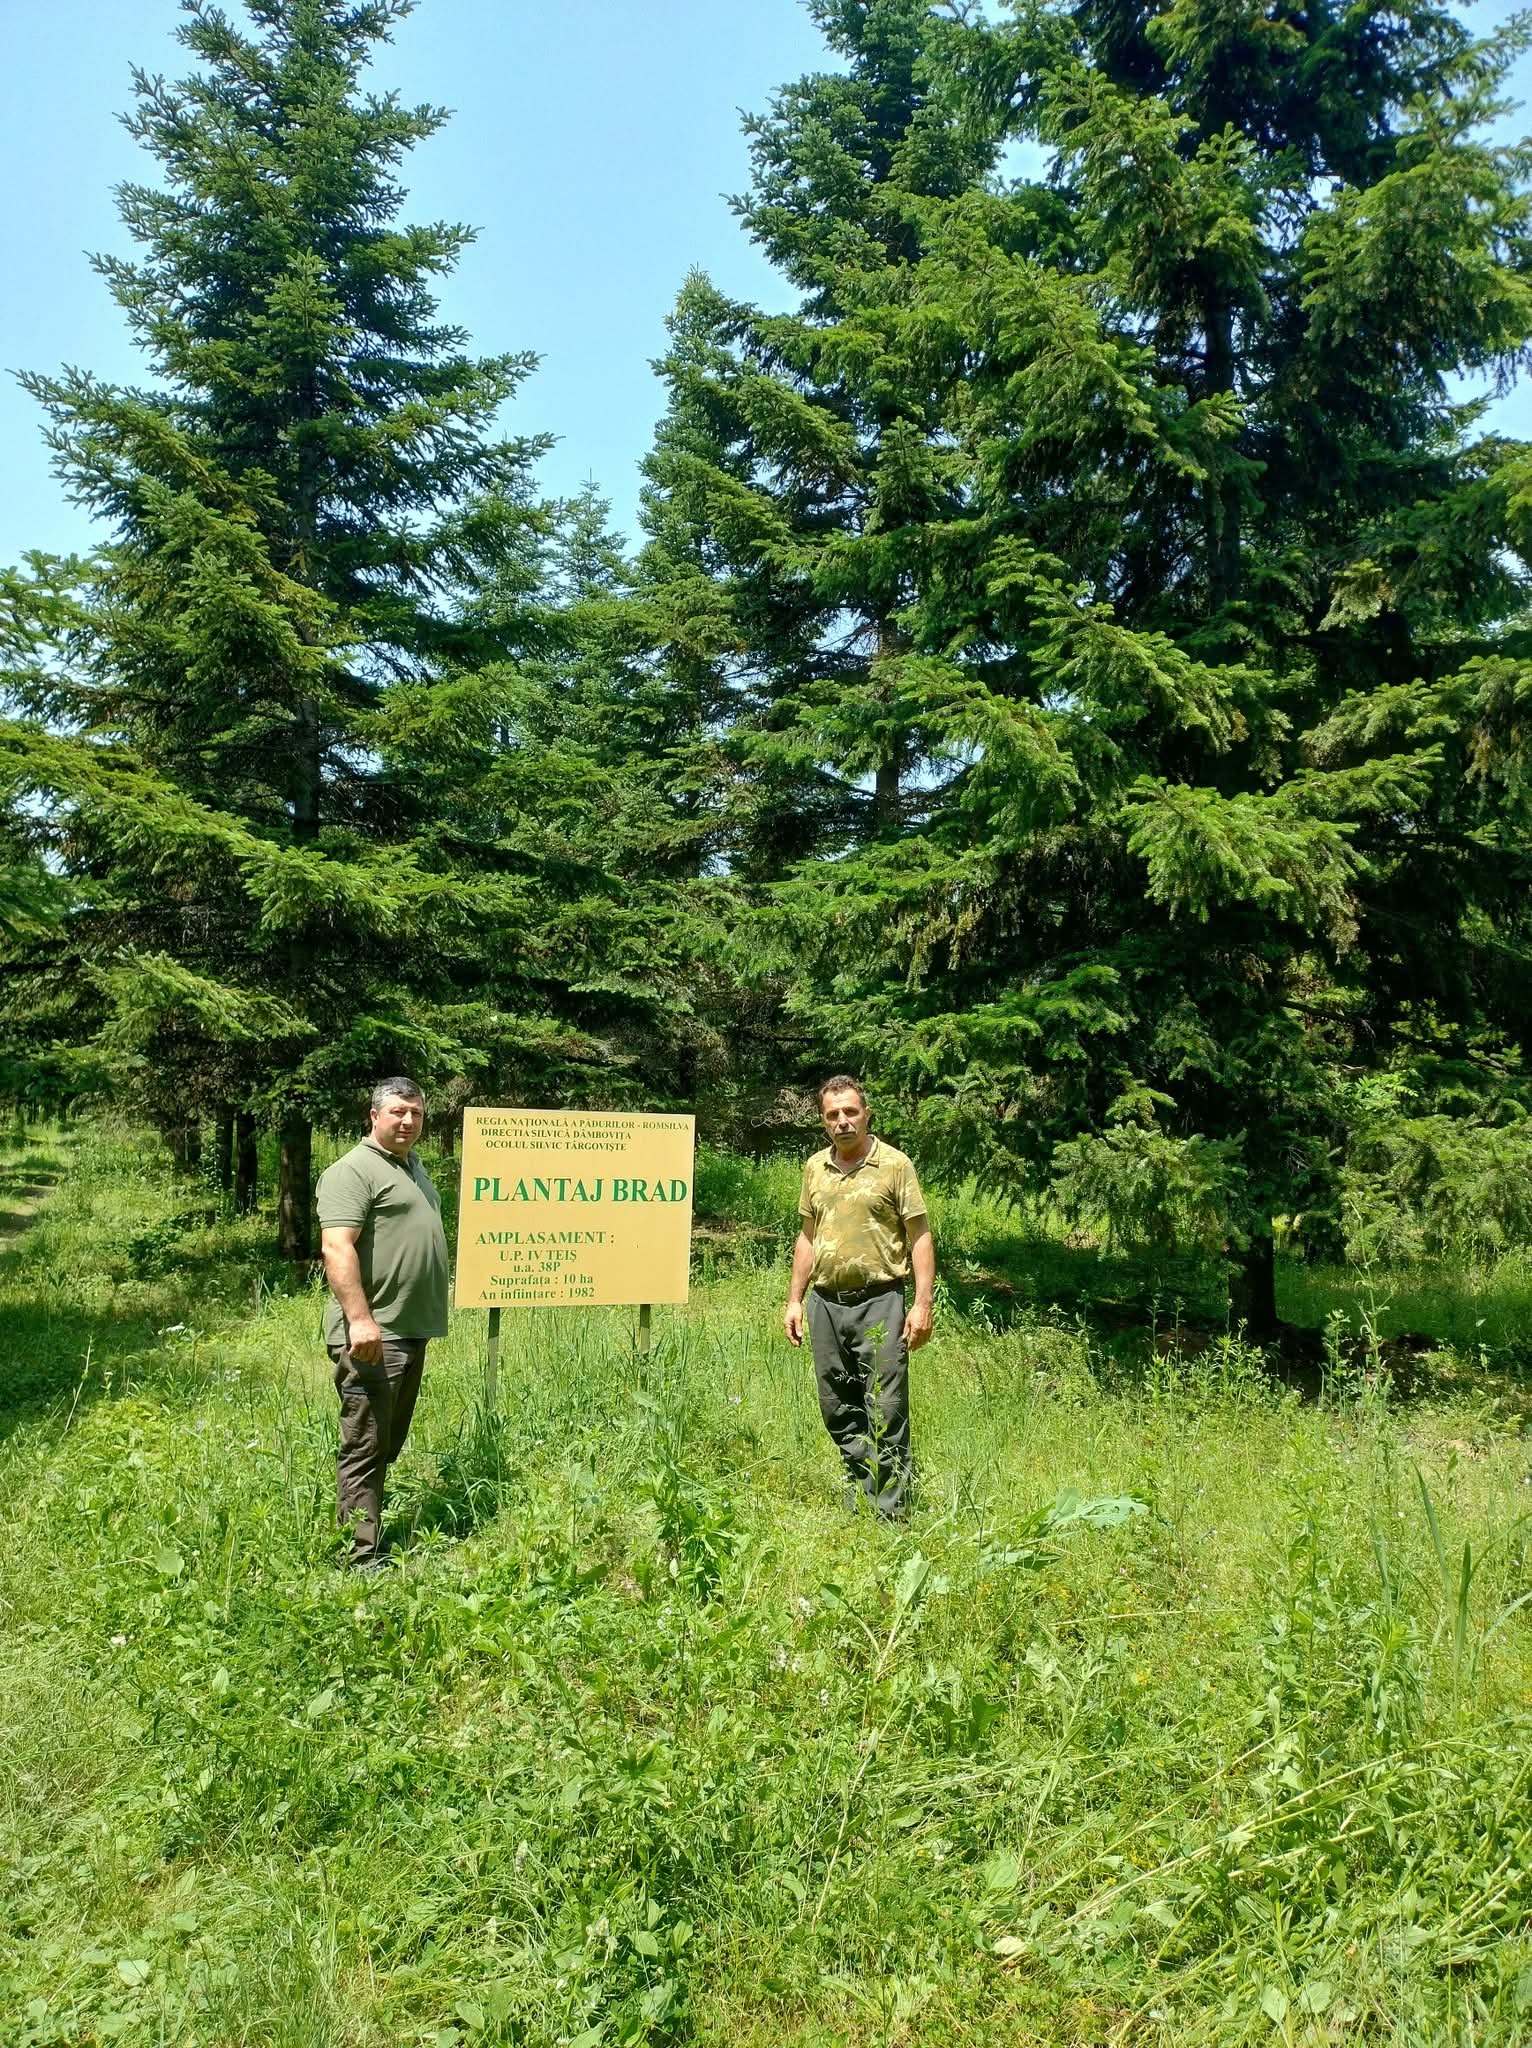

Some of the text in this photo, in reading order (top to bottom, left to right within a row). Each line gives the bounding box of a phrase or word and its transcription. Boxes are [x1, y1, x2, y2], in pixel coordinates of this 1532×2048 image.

[476, 1116, 508, 1126] REGIA
[580, 1118, 635, 1129] PĂDURILOR
[642, 1121, 689, 1131] ROMSILVA
[531, 1129, 571, 1138] SILVICĂ
[486, 1140, 528, 1149] OCOLUL
[530, 1140, 562, 1149] SILVIC
[473, 1177, 688, 1202] PLANTAJ BRAD
[475, 1231, 607, 1245] AMPLASAMENT
[499, 1250, 524, 1261] U.P.
[527, 1250, 542, 1260] IV
[513, 1261, 561, 1273] u.a. 38P
[563, 1274, 576, 1284] 10
[579, 1273, 593, 1284] ha
[479, 1290, 496, 1300] An
[568, 1287, 595, 1298] 1982
